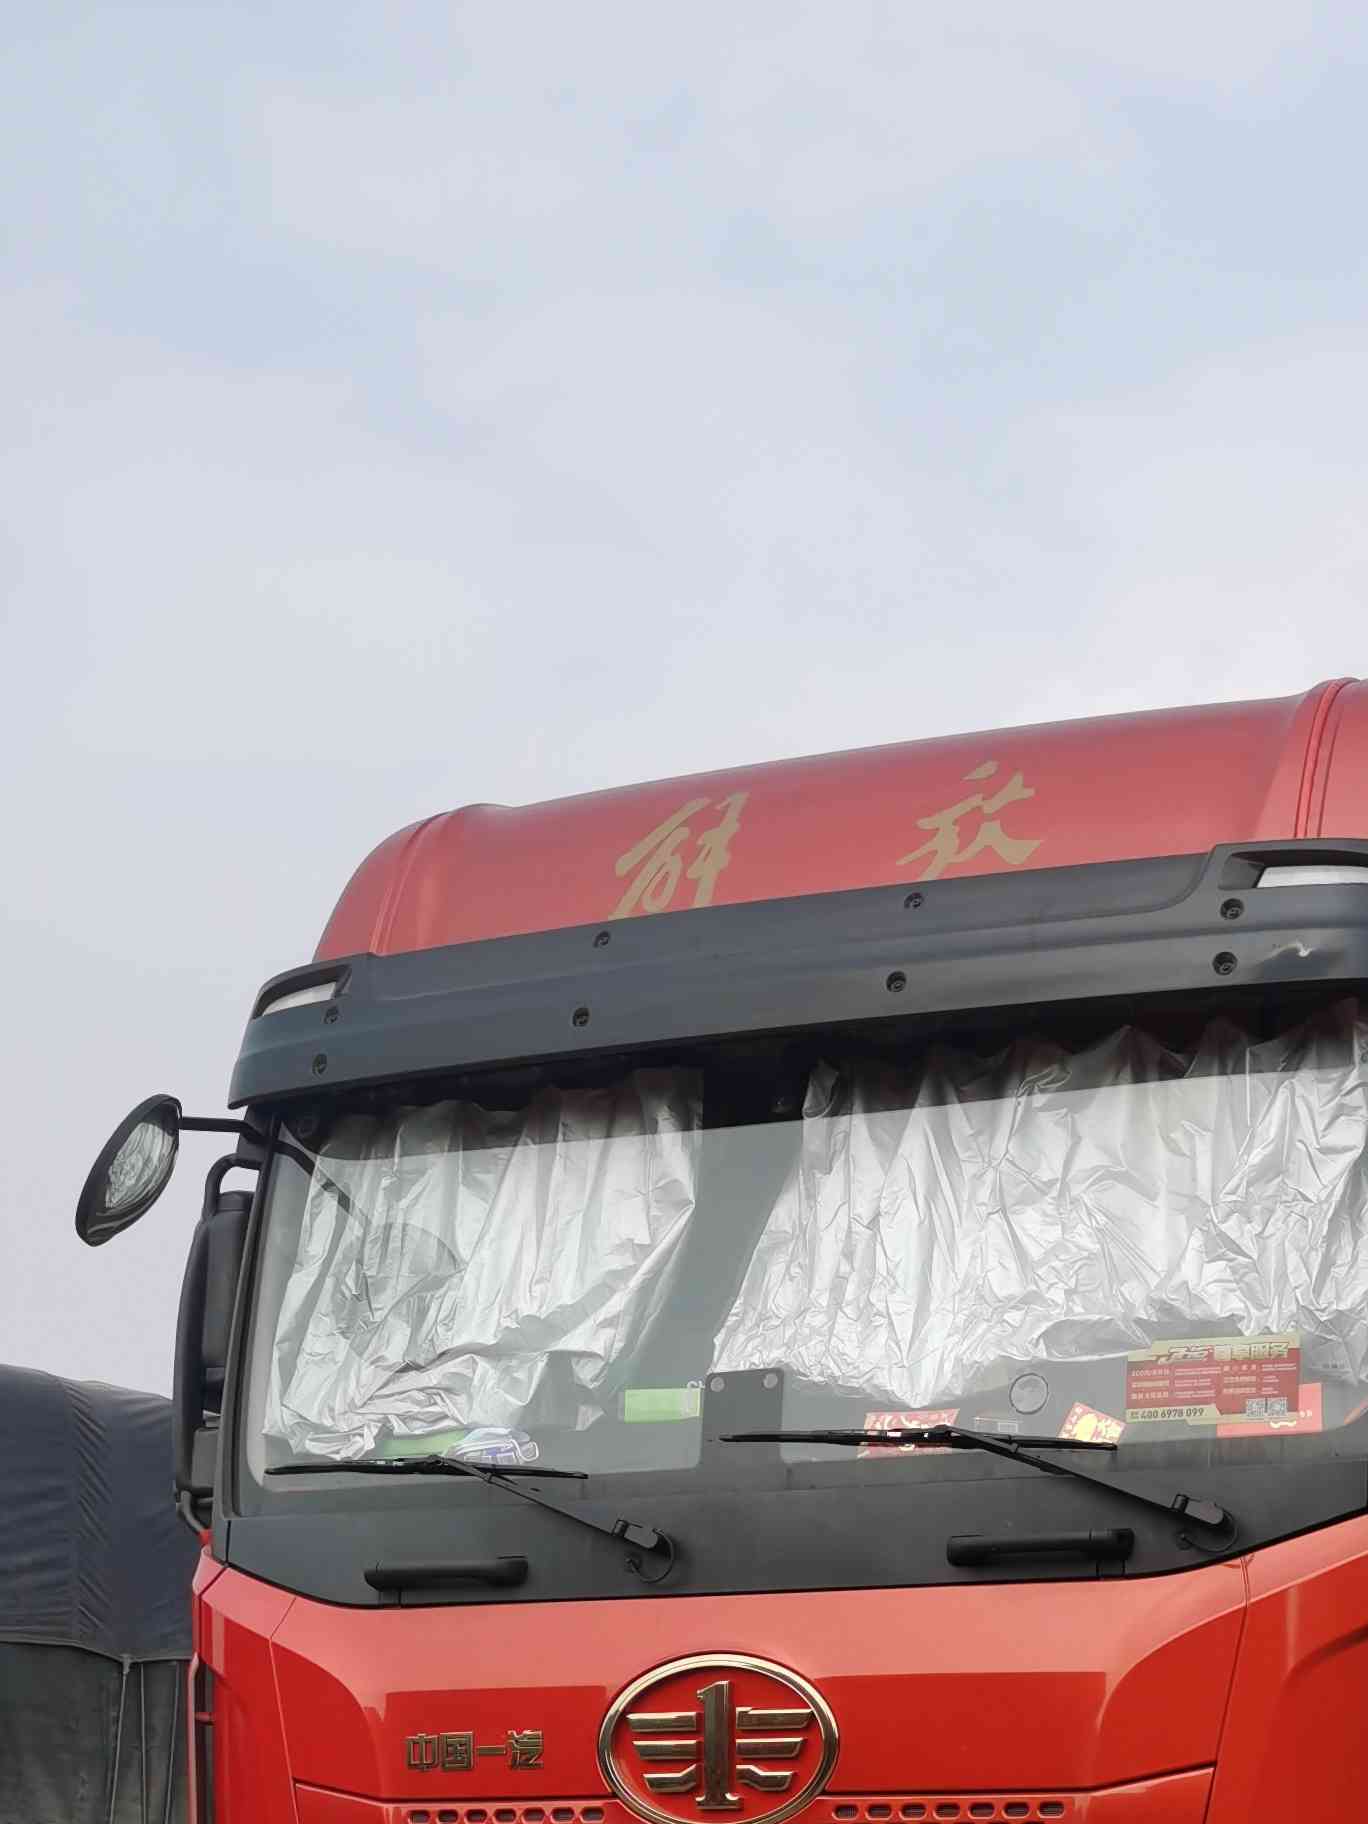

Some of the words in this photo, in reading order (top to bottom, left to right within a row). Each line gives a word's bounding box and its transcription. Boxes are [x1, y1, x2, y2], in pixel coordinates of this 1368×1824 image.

[1186, 1407, 1204, 1417] 099
[406, 1729, 545, 1772] 中国一汽
